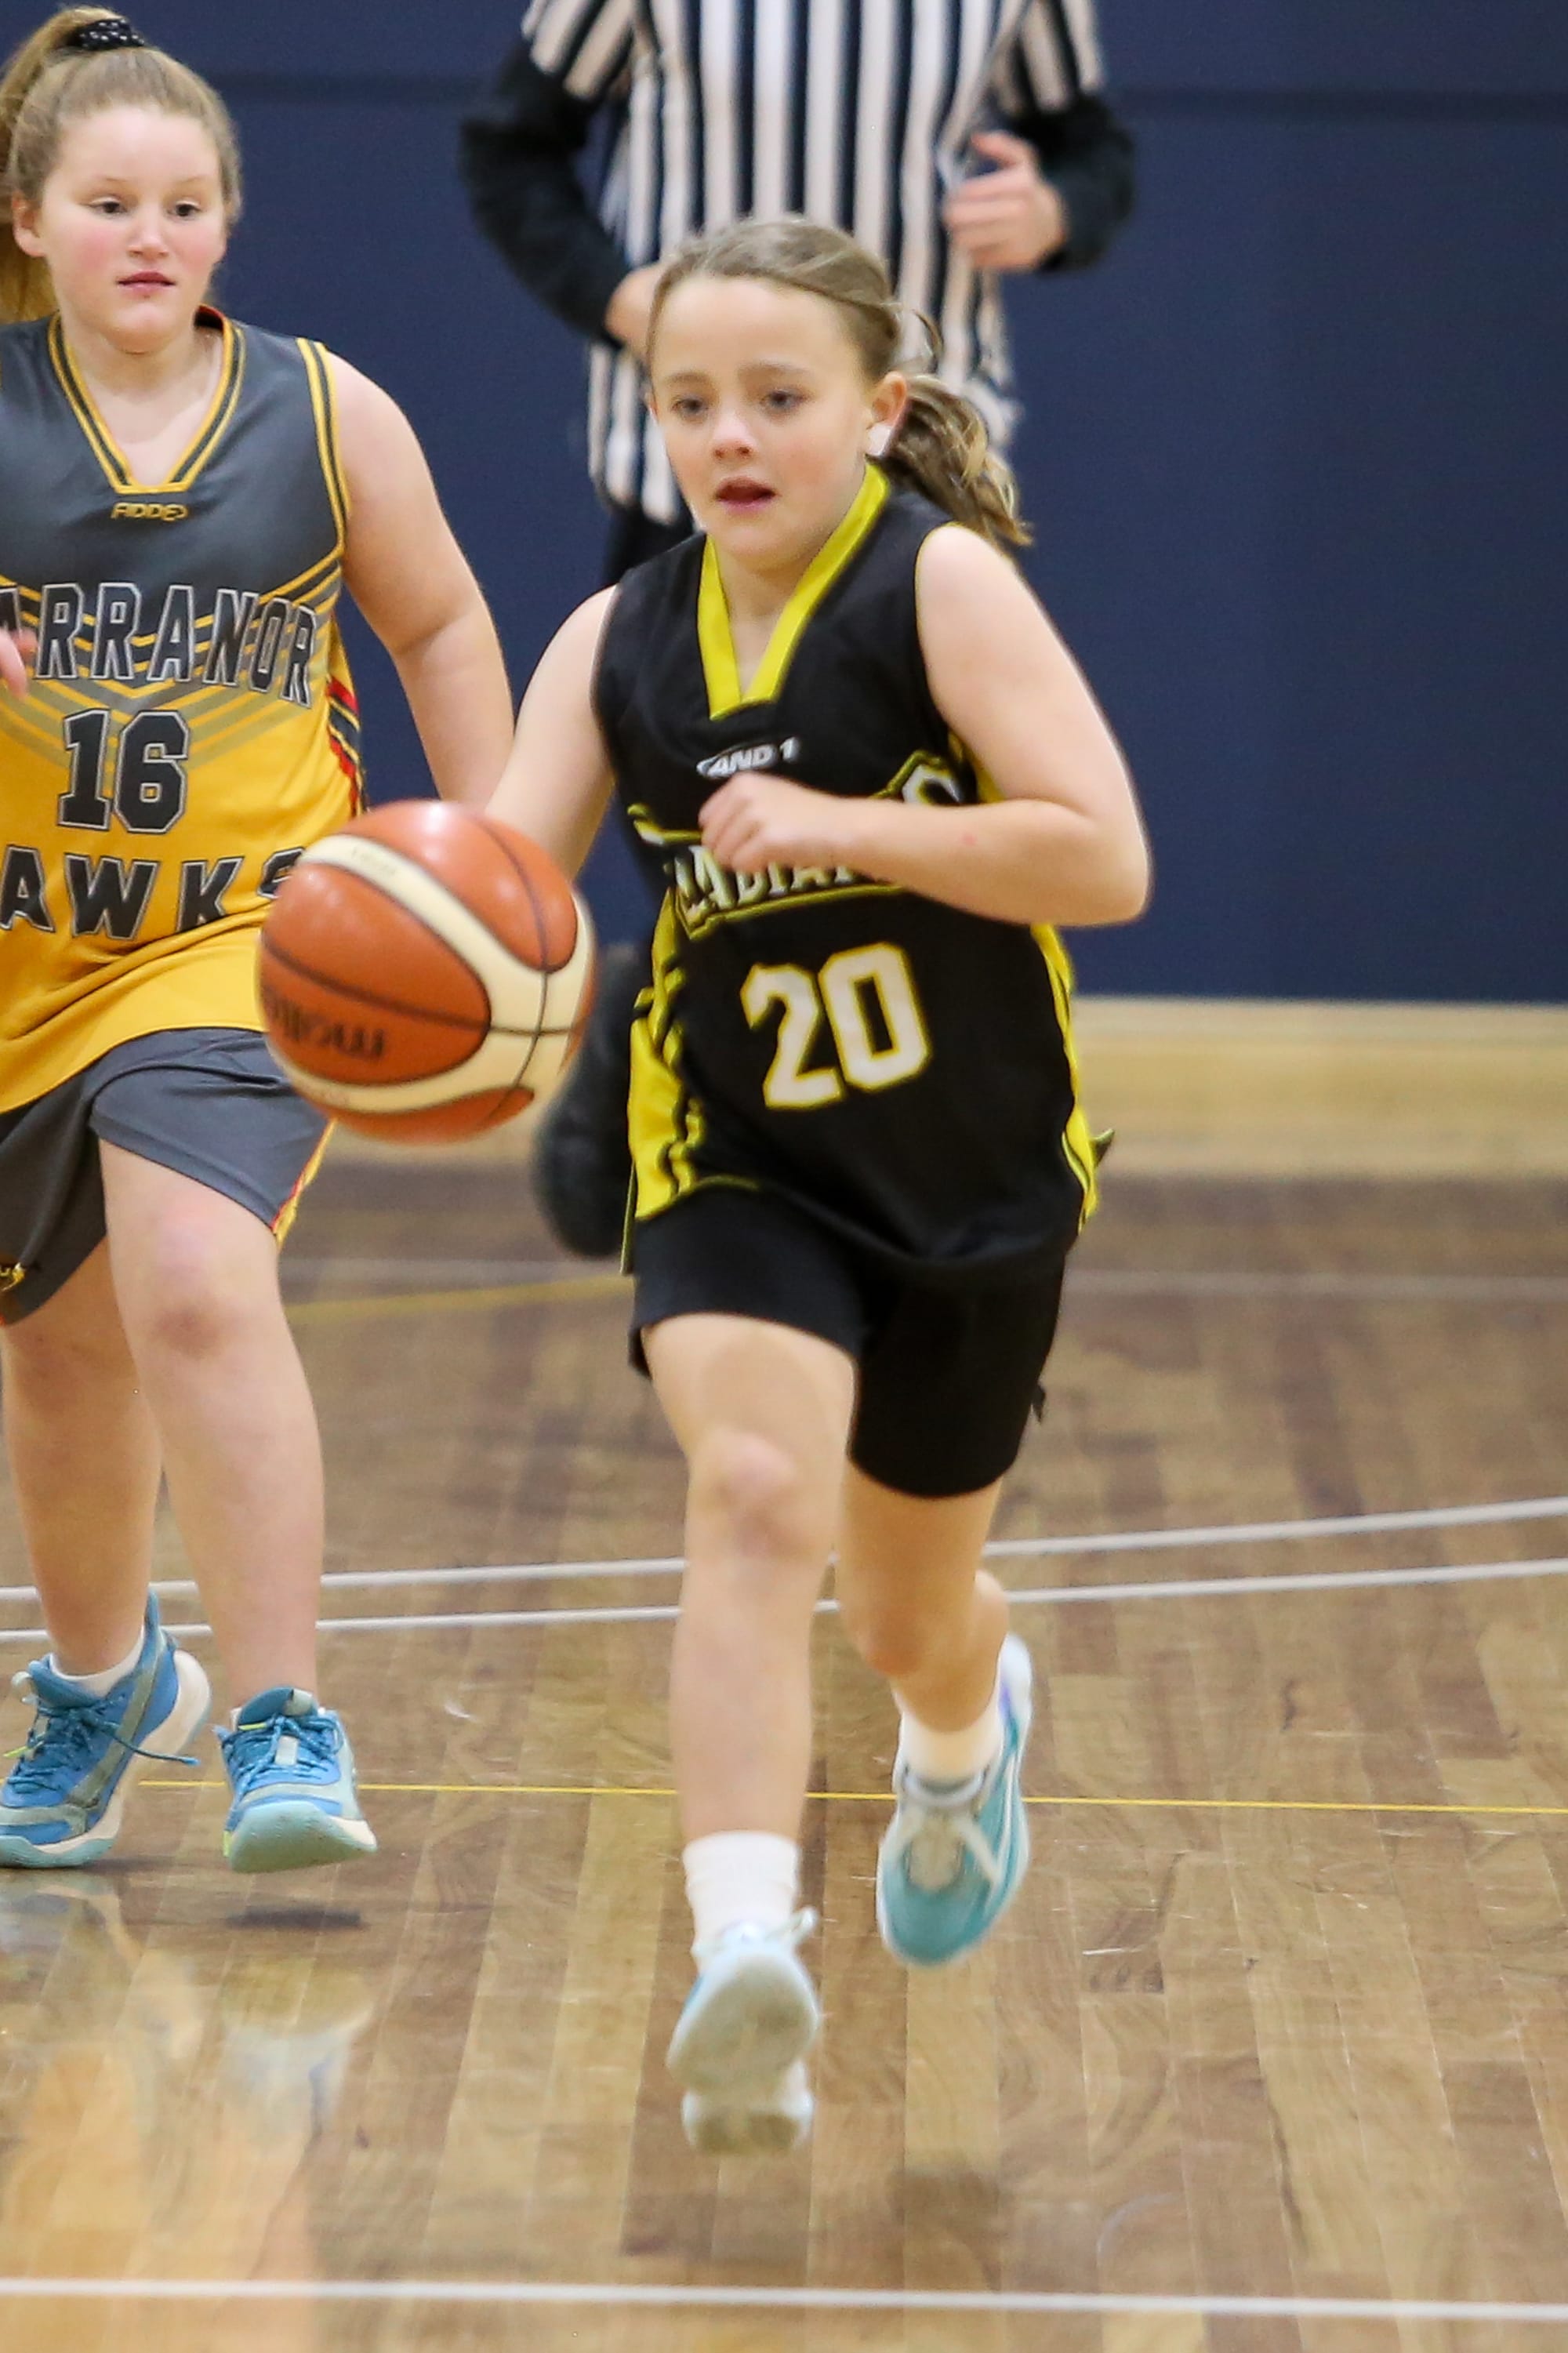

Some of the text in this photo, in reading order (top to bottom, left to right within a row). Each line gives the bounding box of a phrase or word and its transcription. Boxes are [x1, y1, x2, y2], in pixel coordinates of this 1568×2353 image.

[56, 708, 190, 833] 16
[699, 736, 800, 777] AND 1
[739, 942, 932, 1112] 20
